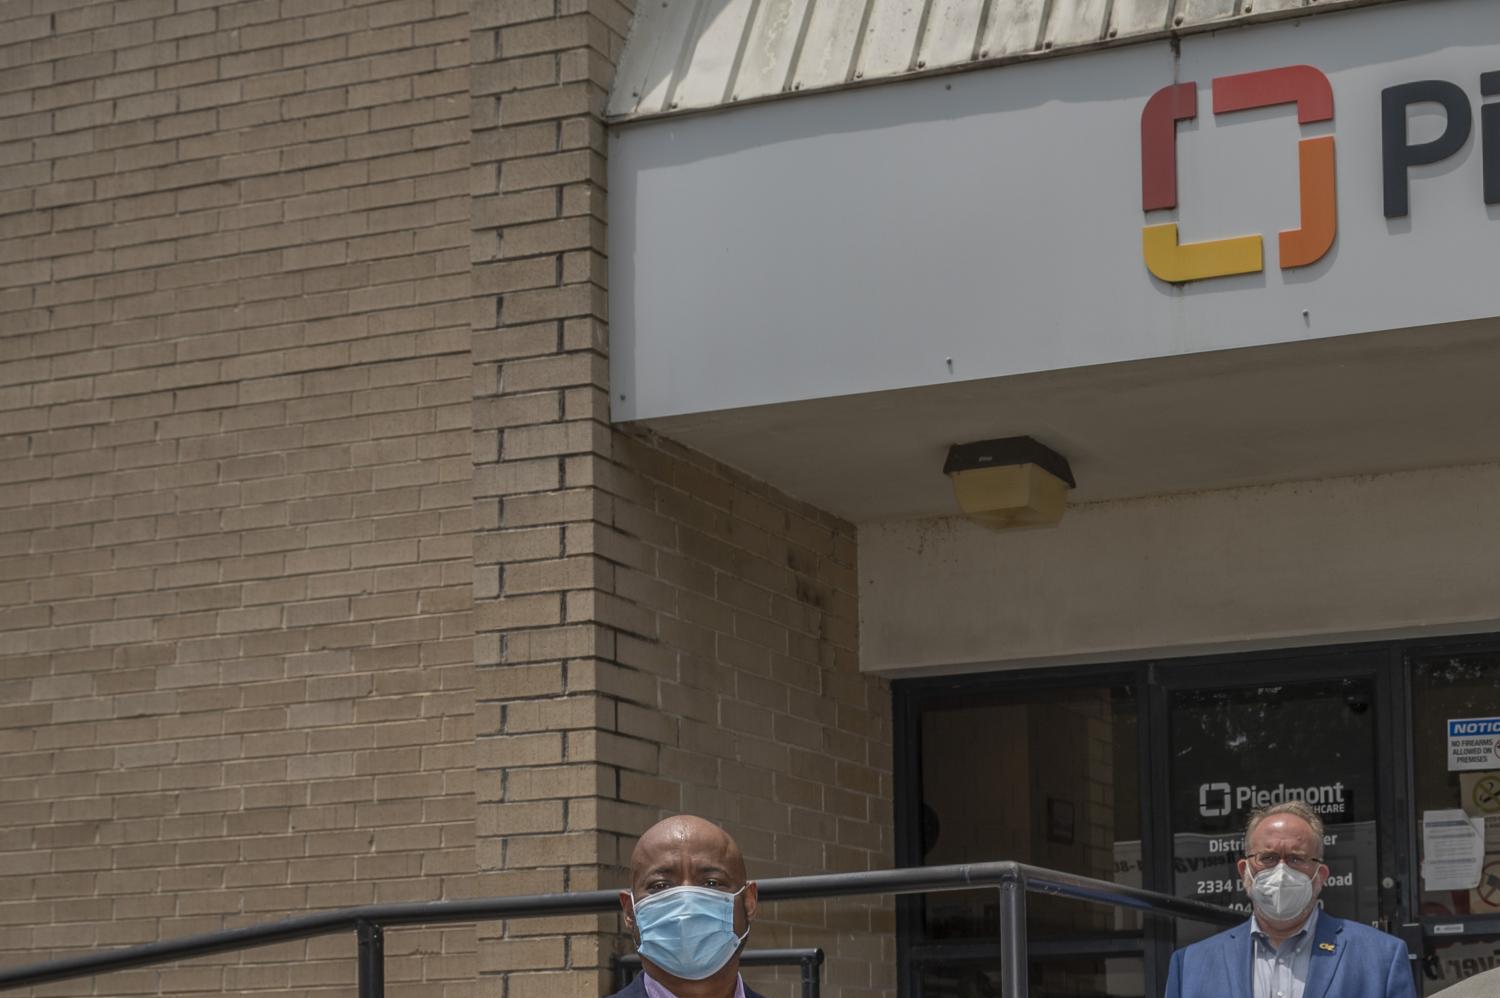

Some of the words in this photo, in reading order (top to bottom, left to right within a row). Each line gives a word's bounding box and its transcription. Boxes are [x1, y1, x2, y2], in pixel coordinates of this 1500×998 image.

[1461, 738, 1493, 747] FIREARMS
[1452, 747, 1482, 755] ALLOWED
[1457, 756, 1488, 764] PREMISES
[1236, 782, 1345, 810] Piedmont
[1313, 803, 1345, 814] HCARE
[1209, 837, 1245, 853] Distri
[1197, 879, 1233, 894] 2334
